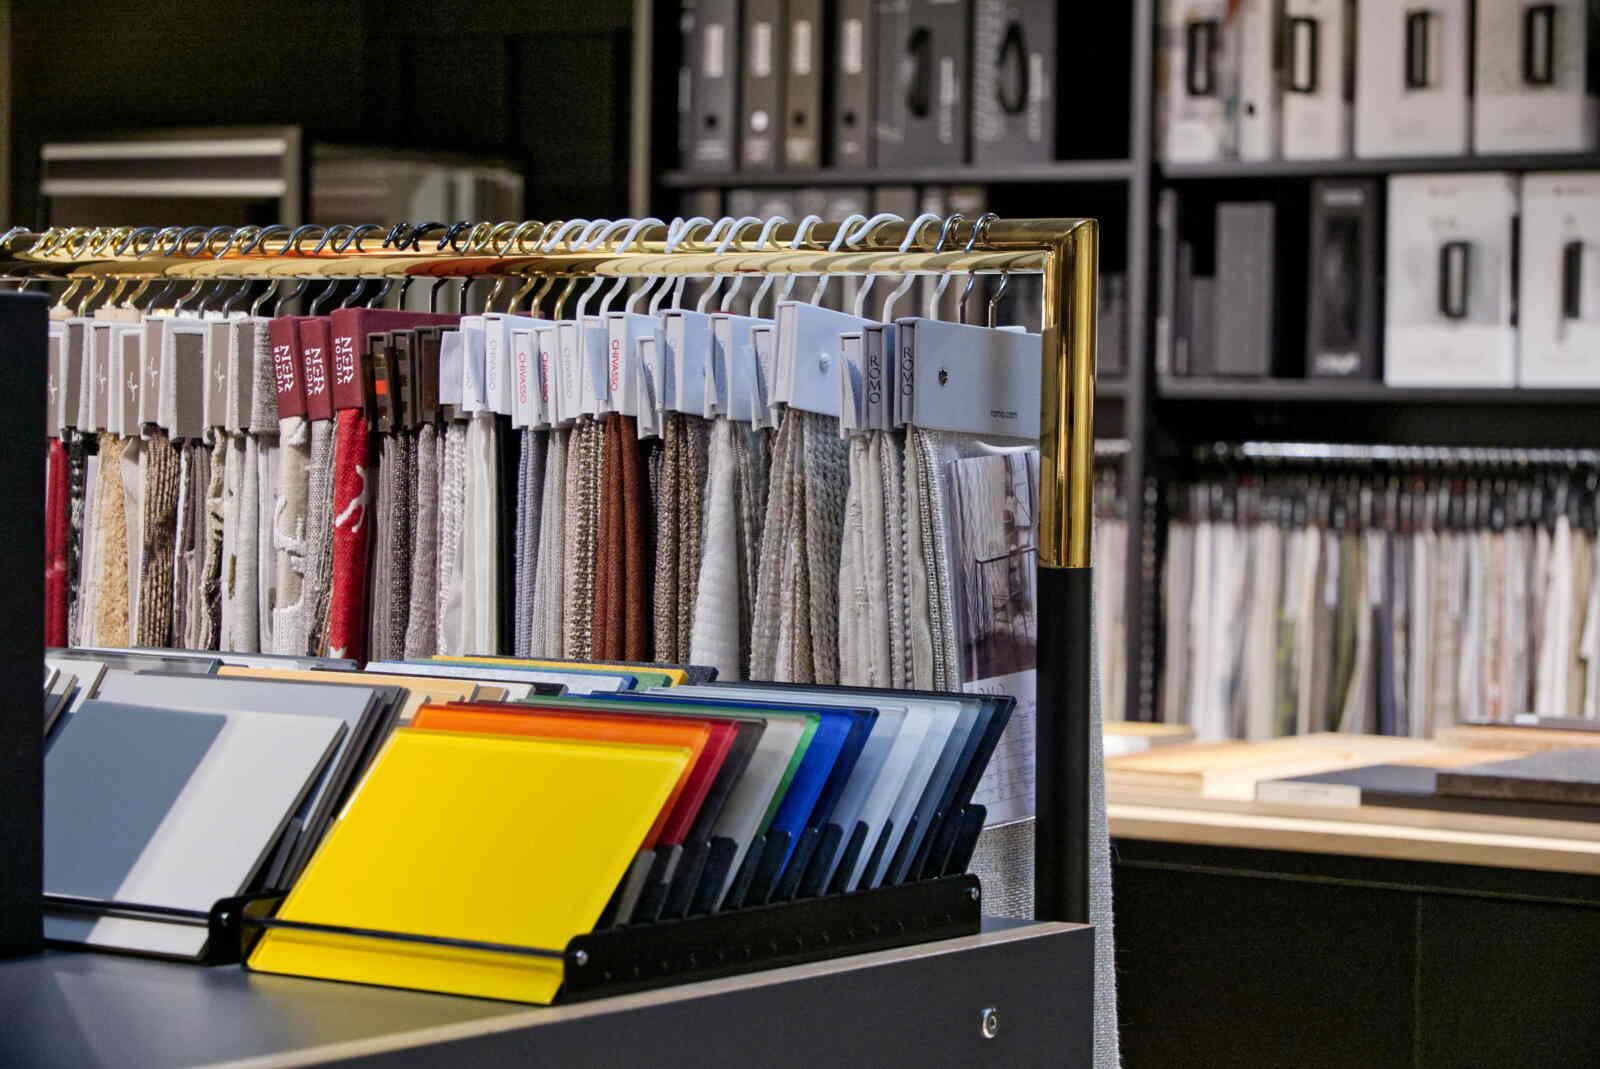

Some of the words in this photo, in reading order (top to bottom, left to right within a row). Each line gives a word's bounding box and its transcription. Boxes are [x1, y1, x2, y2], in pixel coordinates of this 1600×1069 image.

[273, 346, 283, 393] VICTOR
[305, 349, 313, 395] VICTOR
[488, 338, 498, 391] CHIVASSO
[518, 352, 528, 404] CHIVASSO
[541, 351, 549, 404] CHIVASSO
[610, 339, 620, 392] CHIVASSO
[869, 355, 880, 404] ROMO
[902, 347, 914, 396] ROMO
